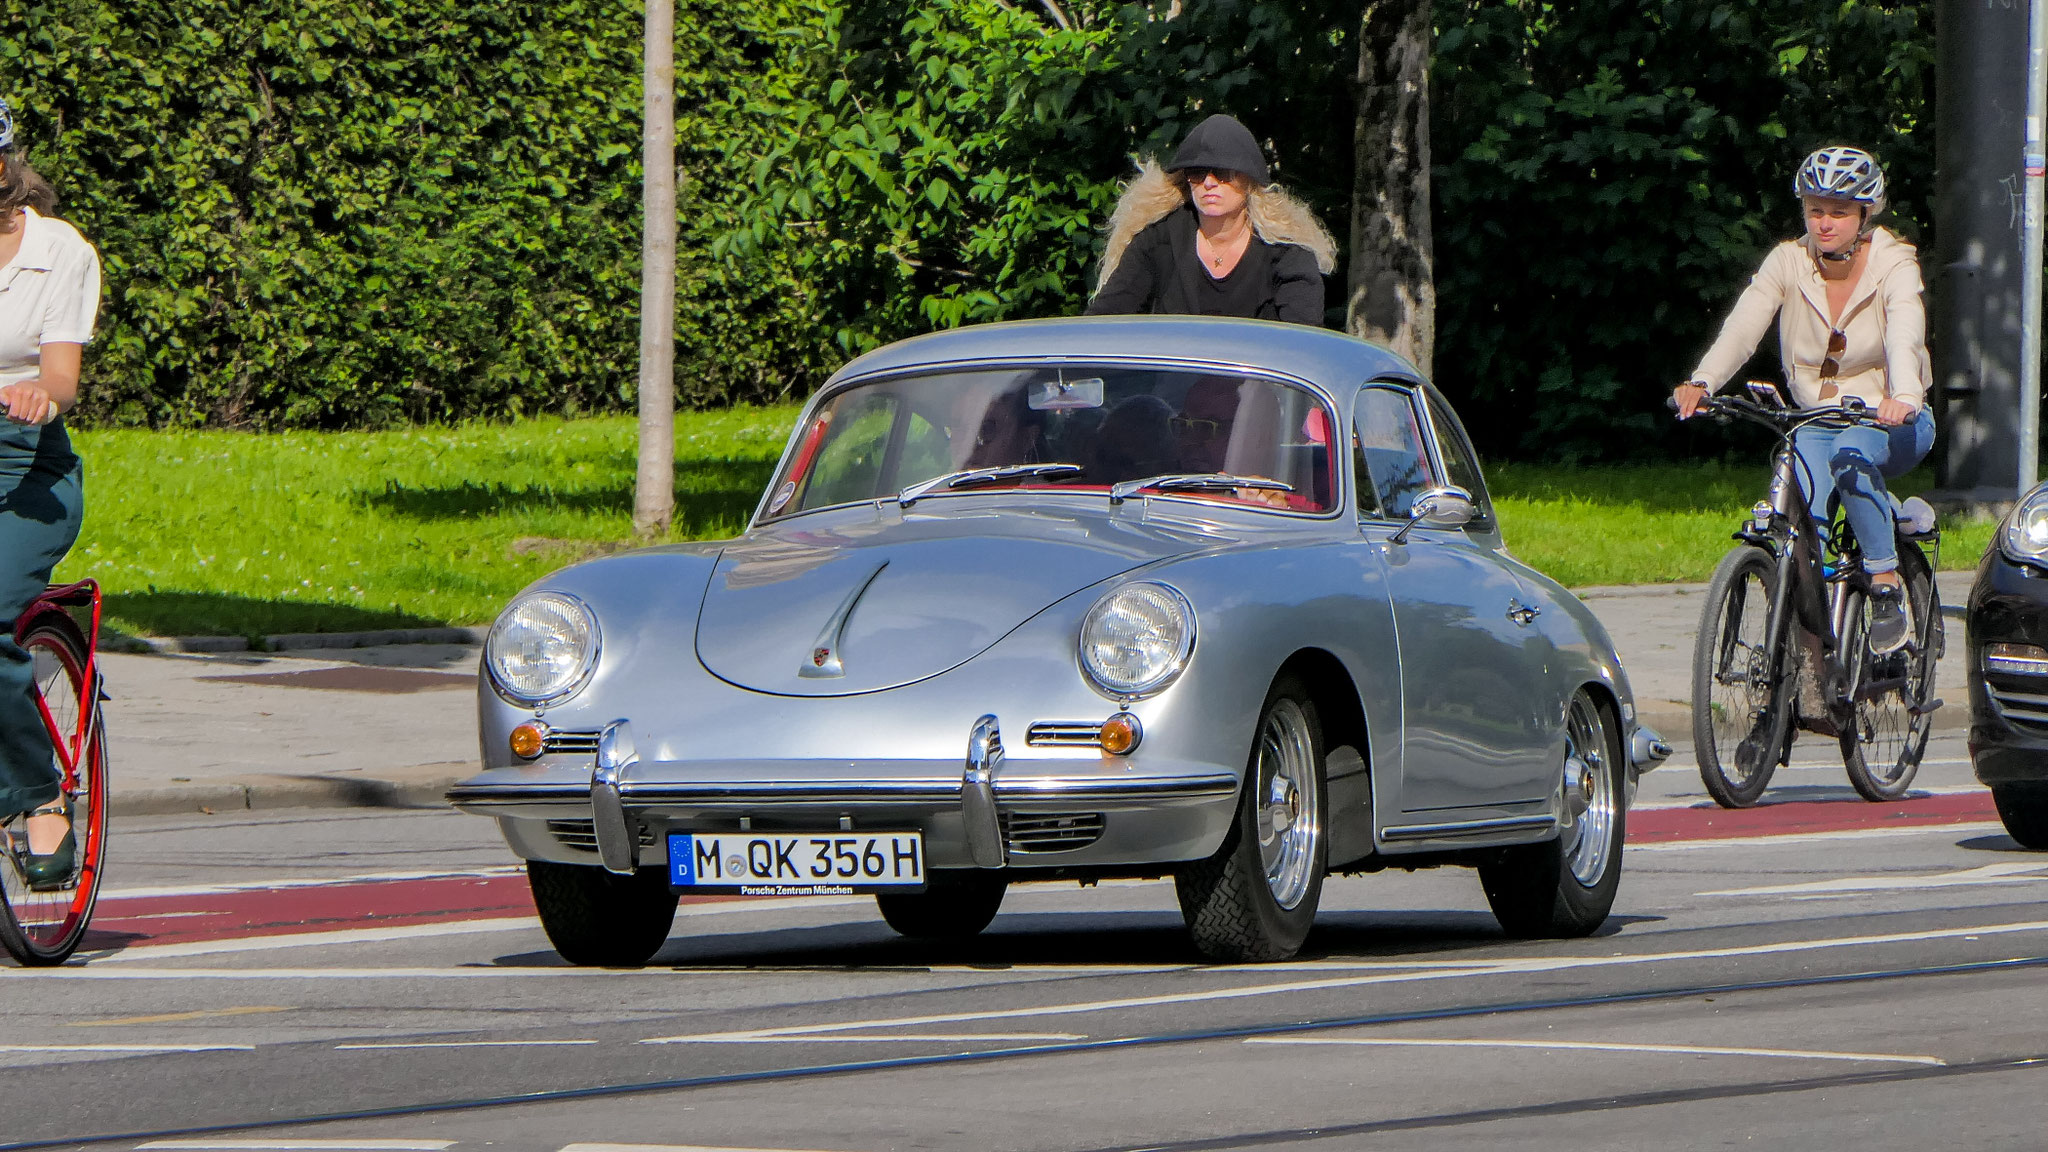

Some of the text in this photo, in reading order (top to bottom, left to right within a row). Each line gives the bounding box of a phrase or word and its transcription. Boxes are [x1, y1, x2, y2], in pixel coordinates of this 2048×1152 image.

[696, 839, 722, 877] M
[748, 839, 800, 877] QK
[679, 864, 688, 875] D
[741, 884, 853, 895] Porsche Zentrum München
